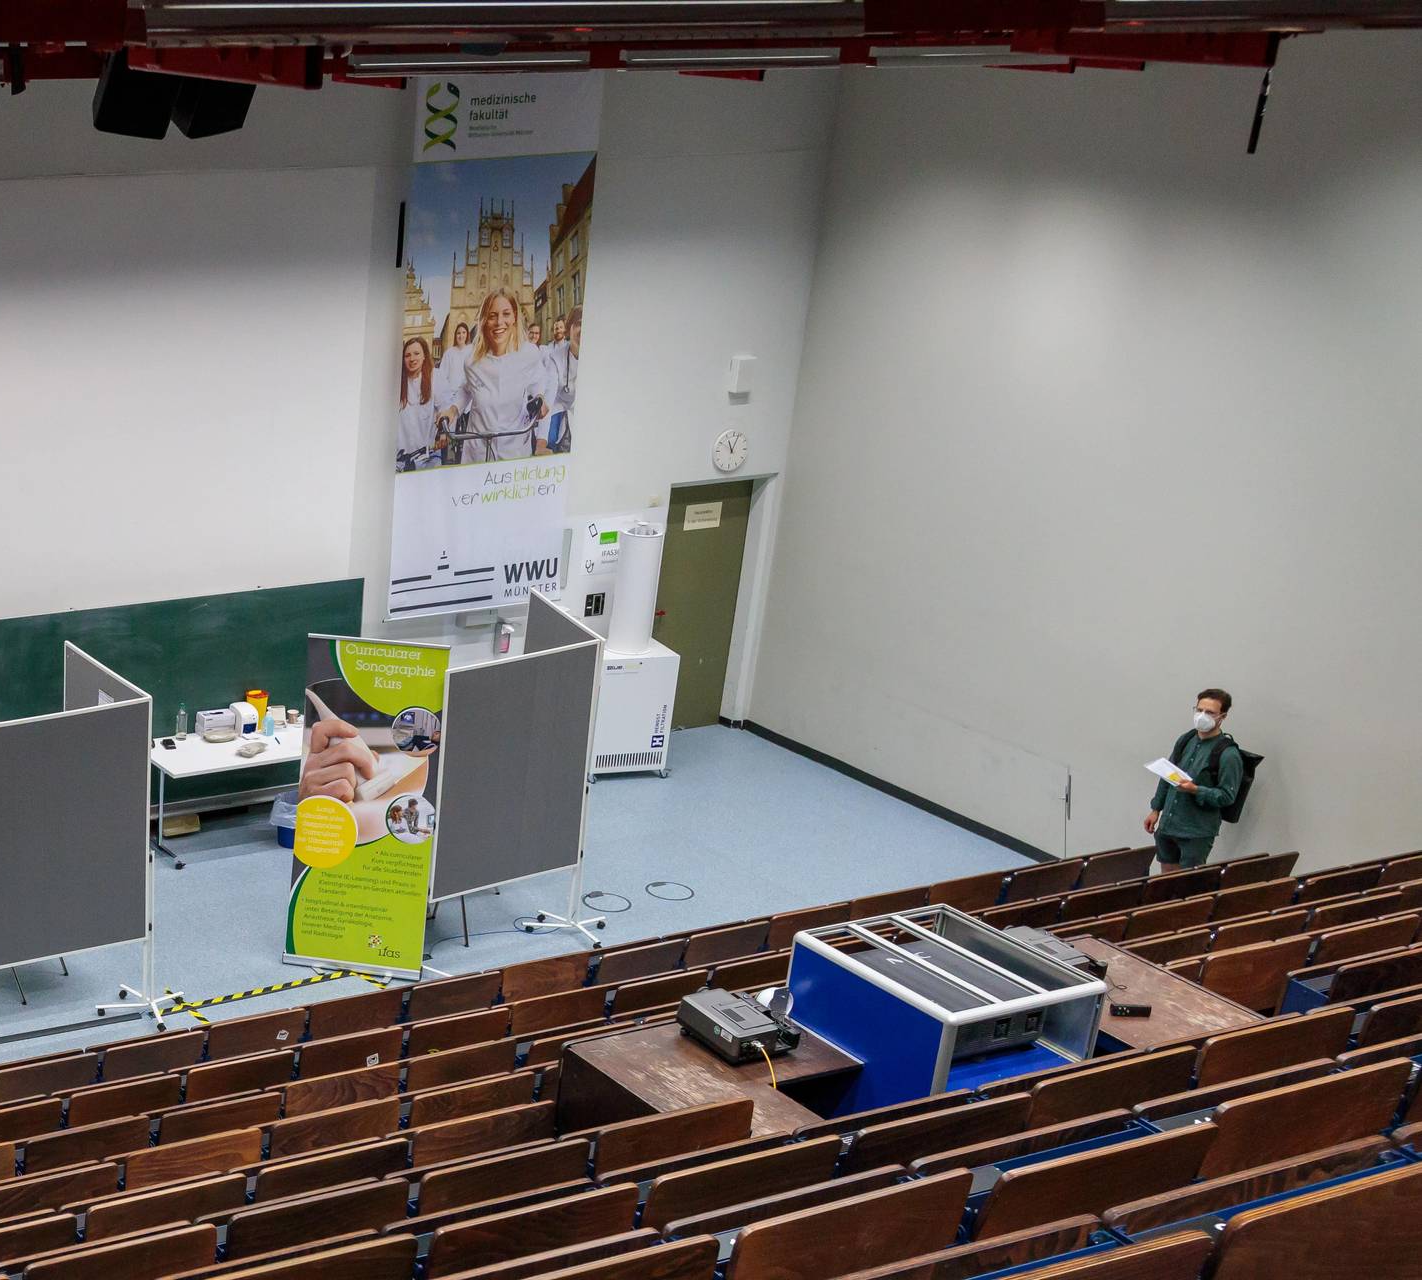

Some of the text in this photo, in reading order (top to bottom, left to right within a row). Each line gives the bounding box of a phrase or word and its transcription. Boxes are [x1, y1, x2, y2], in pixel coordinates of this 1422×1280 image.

[470, 92, 537, 105] medizinische
[469, 109, 508, 121] fakultät
[484, 465, 566, 486] Ausbildung
[504, 557, 558, 585] WWU
[504, 582, 557, 598] MÜNTER
[345, 643, 422, 661] Curricularer
[355, 660, 436, 677] Sonographie
[373, 676, 403, 690] Kurs
[378, 946, 401, 959] ifas
